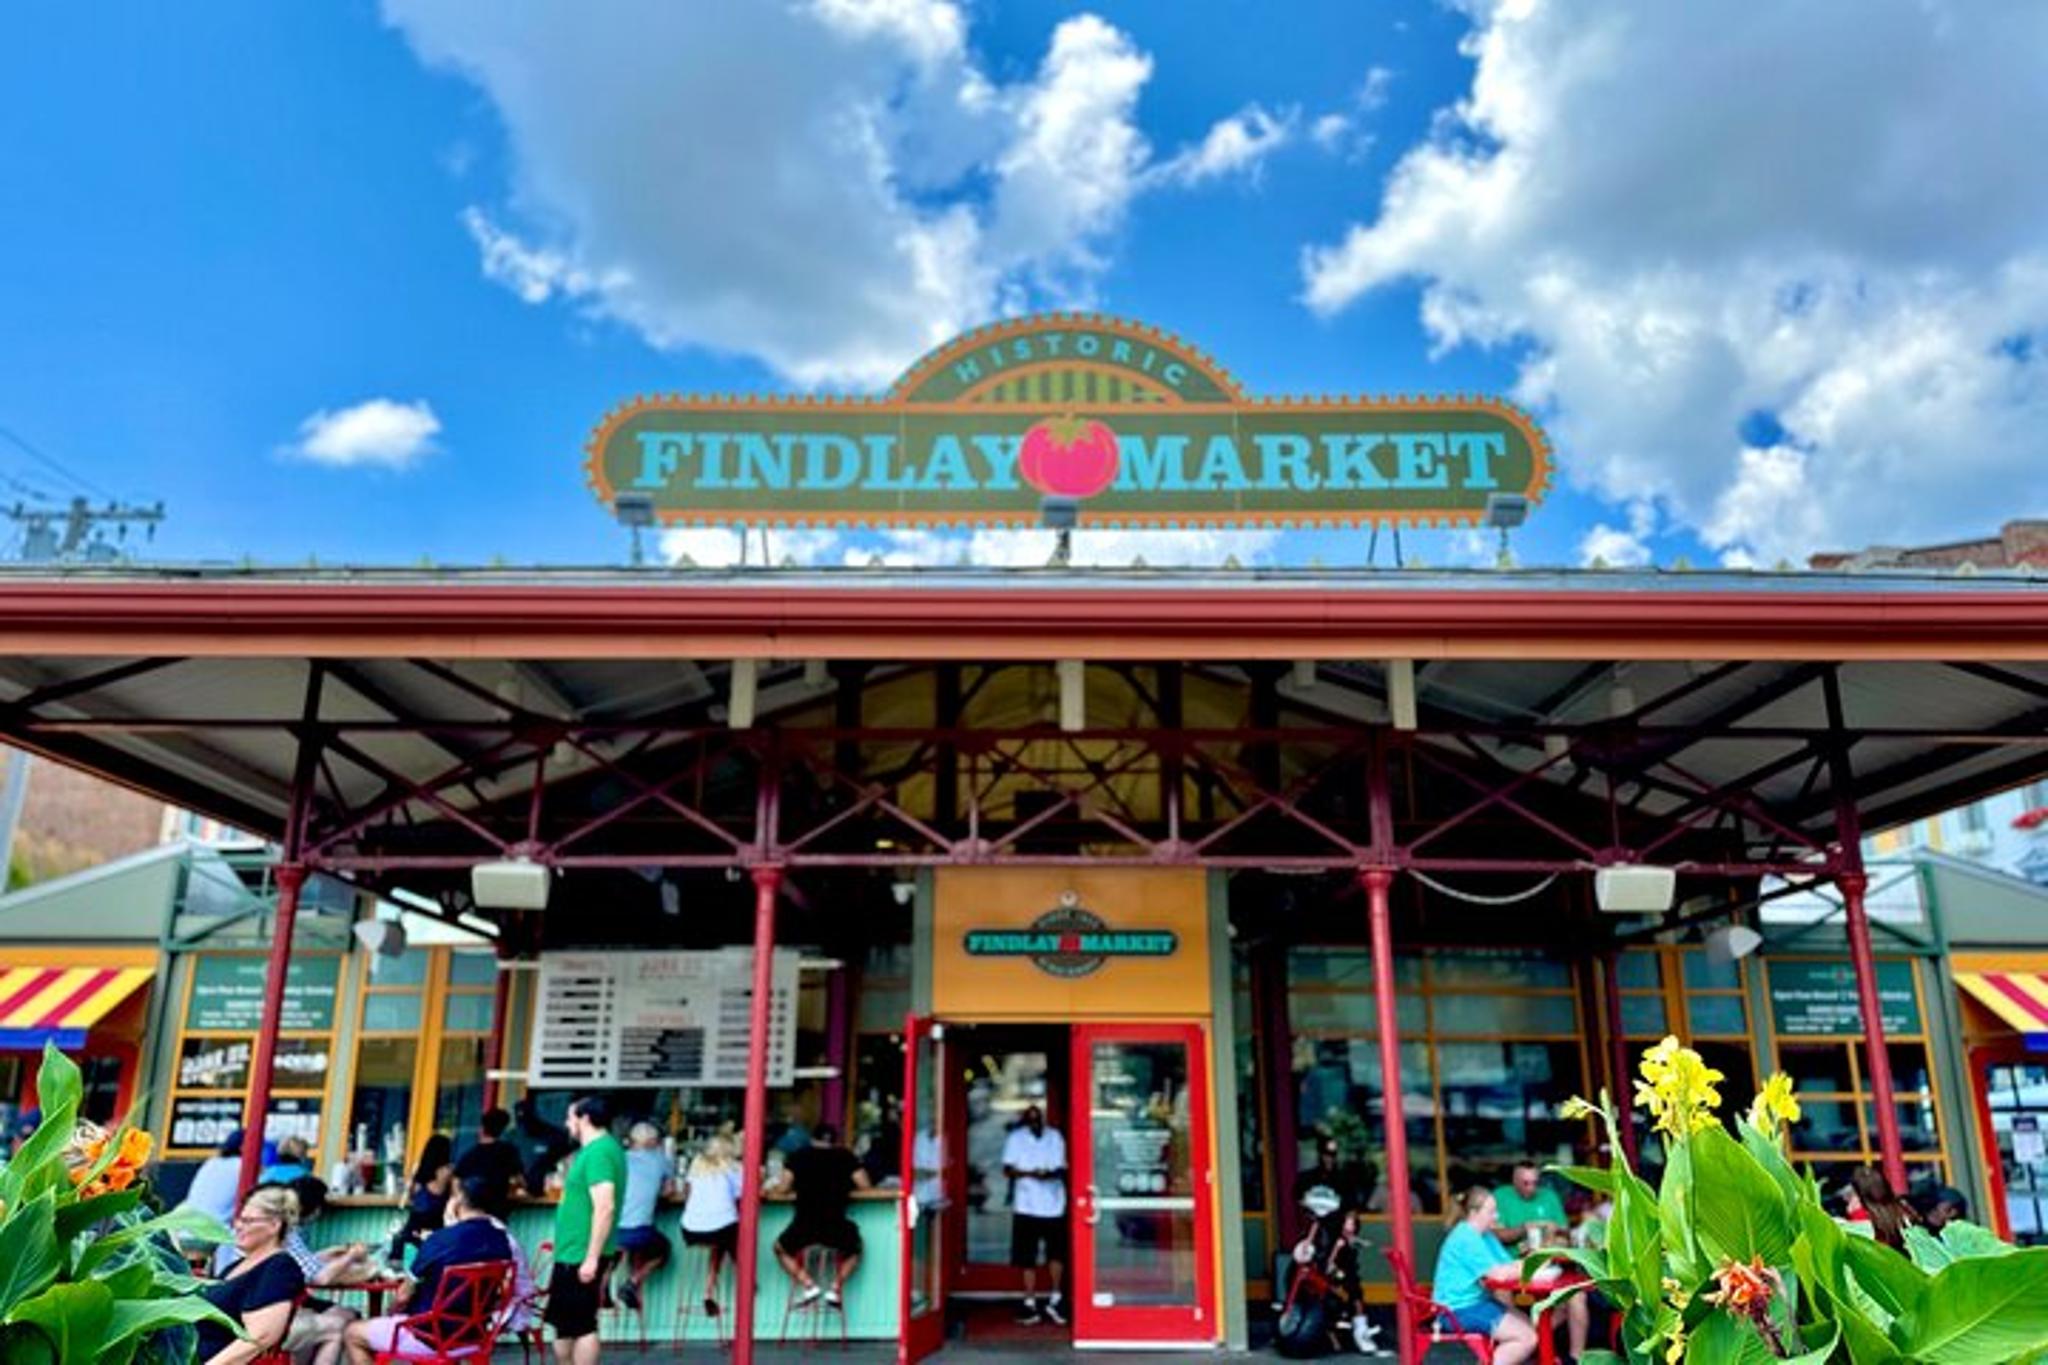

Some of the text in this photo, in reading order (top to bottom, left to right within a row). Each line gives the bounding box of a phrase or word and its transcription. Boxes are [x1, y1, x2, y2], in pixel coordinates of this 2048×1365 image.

[954, 334, 1187, 387] HISTORIC
[633, 431, 1506, 492] FINDLAY MARKET
[968, 934, 1174, 952] FINDLAY MARKET
